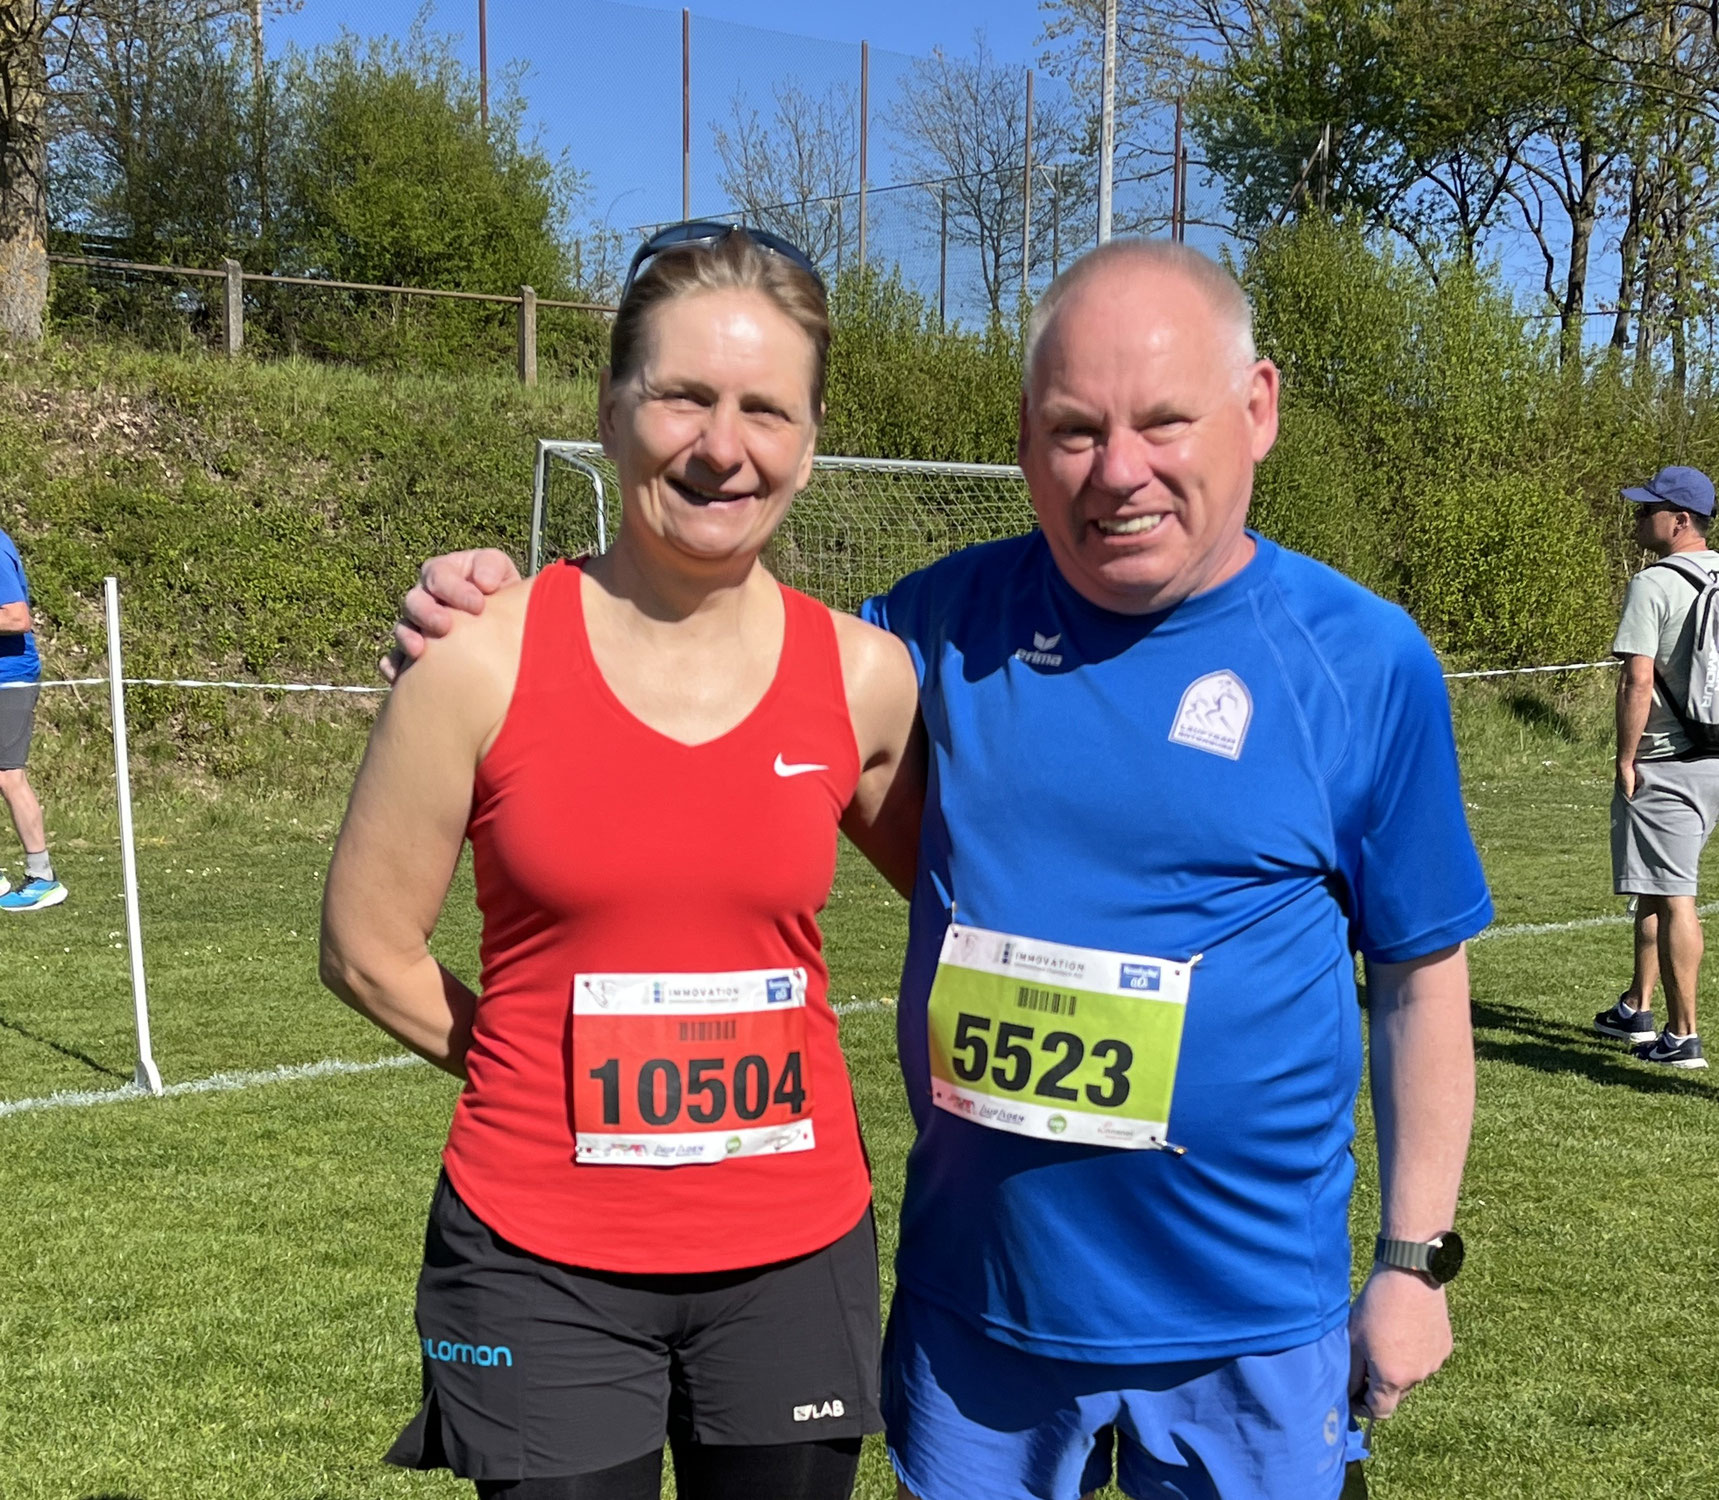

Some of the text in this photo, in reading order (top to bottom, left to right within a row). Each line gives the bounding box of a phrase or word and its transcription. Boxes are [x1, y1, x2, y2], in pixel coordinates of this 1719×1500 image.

[1014, 648, 1063, 667] erima
[1015, 951, 1085, 972] IMMOVATION
[668, 987, 740, 997] IMMOVATION
[952, 1012, 1134, 1108] 5523
[589, 1051, 806, 1126] 10504
